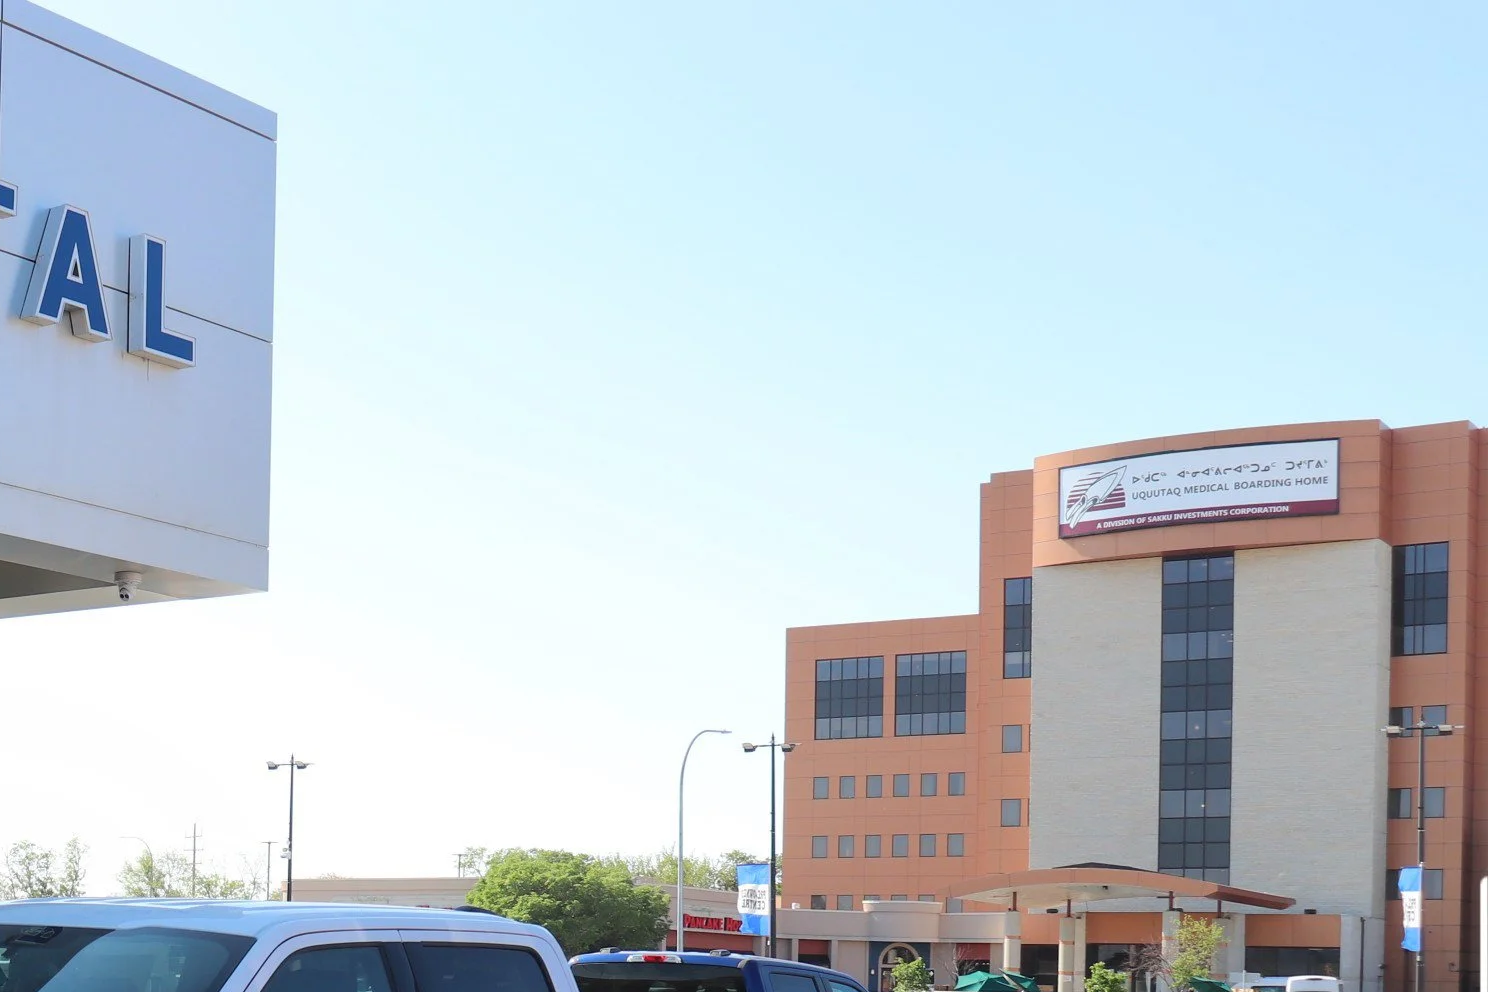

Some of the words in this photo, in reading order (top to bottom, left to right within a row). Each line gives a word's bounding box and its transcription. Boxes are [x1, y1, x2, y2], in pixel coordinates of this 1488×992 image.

[1132, 487, 1181, 500] UQUUTAQ
[1184, 483, 1230, 495] MEDICAL
[1234, 478, 1292, 491] BOARDING
[1295, 475, 1329, 486] HOME
[1103, 518, 1135, 528] DIVISION
[1136, 516, 1147, 524] OF
[1147, 513, 1173, 523] SAKKU
[1174, 509, 1228, 520] INVESTMENTS
[1229, 505, 1289, 516] CORPORATION
[683, 914, 724, 930] PANCAKE
